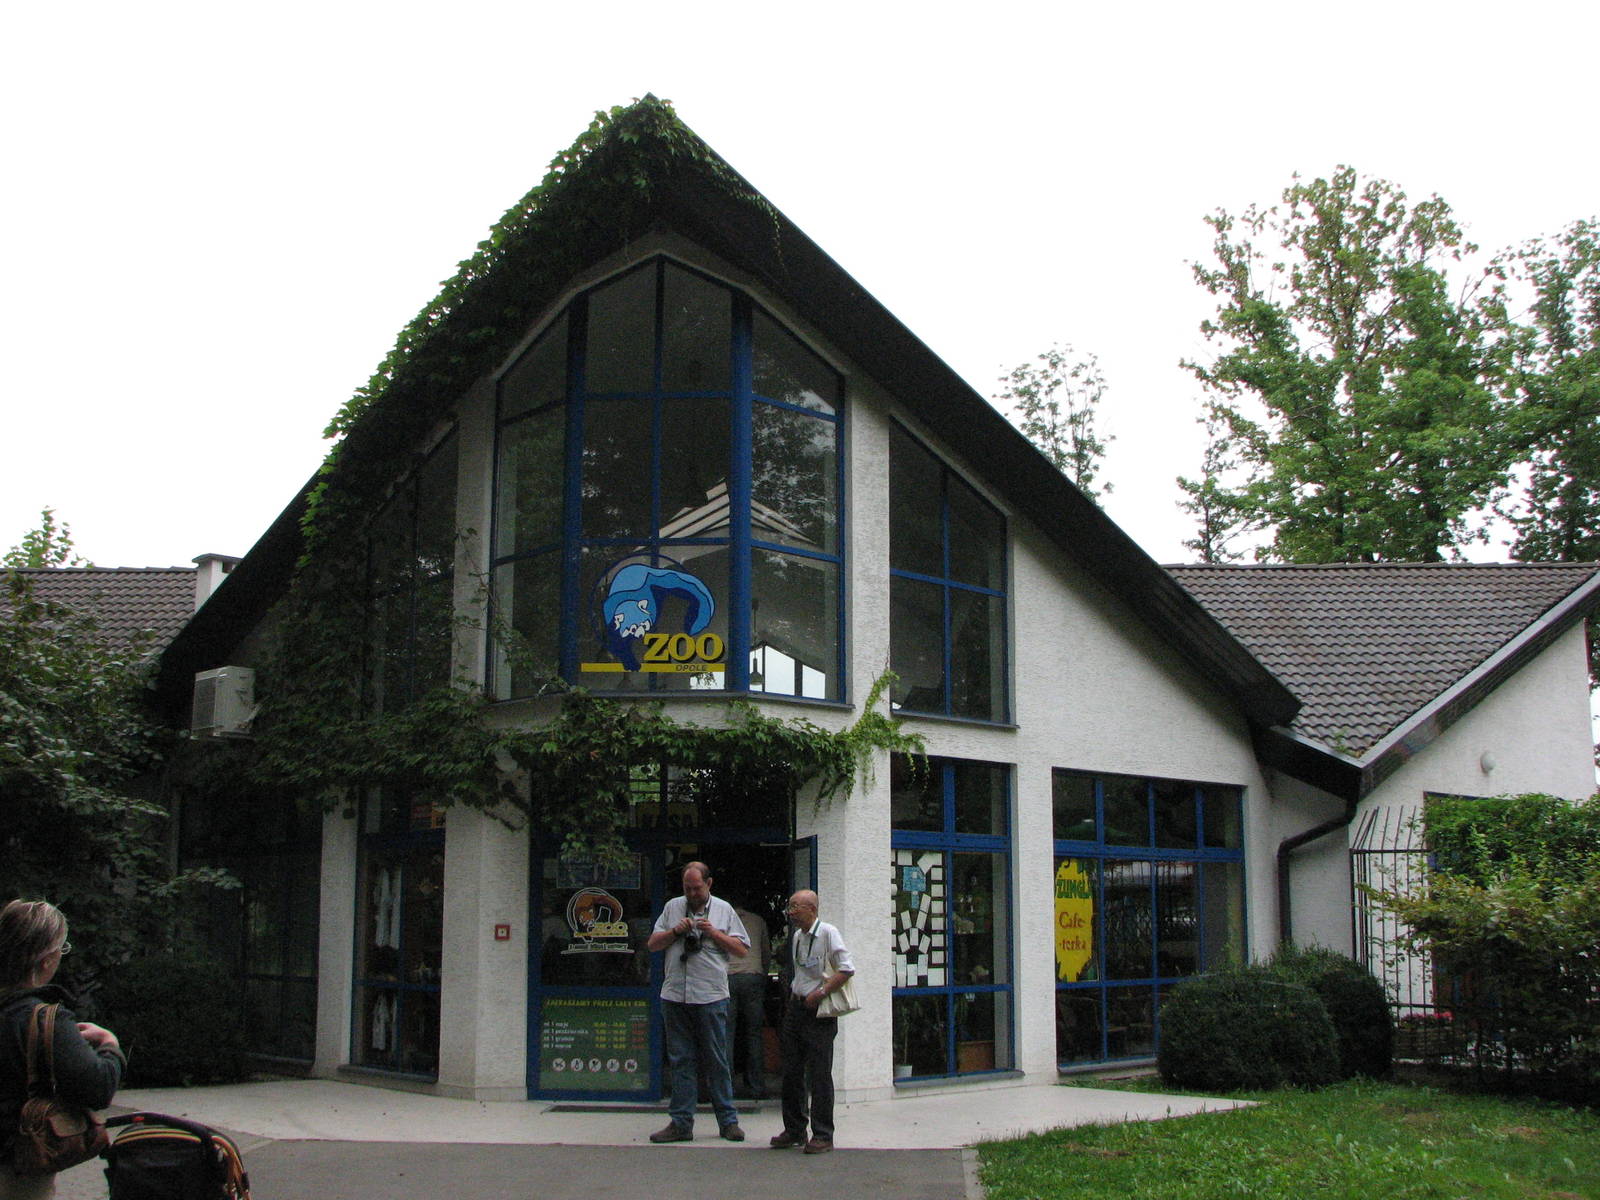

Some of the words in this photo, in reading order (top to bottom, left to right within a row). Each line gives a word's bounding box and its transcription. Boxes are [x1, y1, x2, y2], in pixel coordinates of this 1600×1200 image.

[643, 633, 725, 661] ZOO
[675, 664, 708, 672] OPOLE
[592, 921, 628, 934] ZOO
